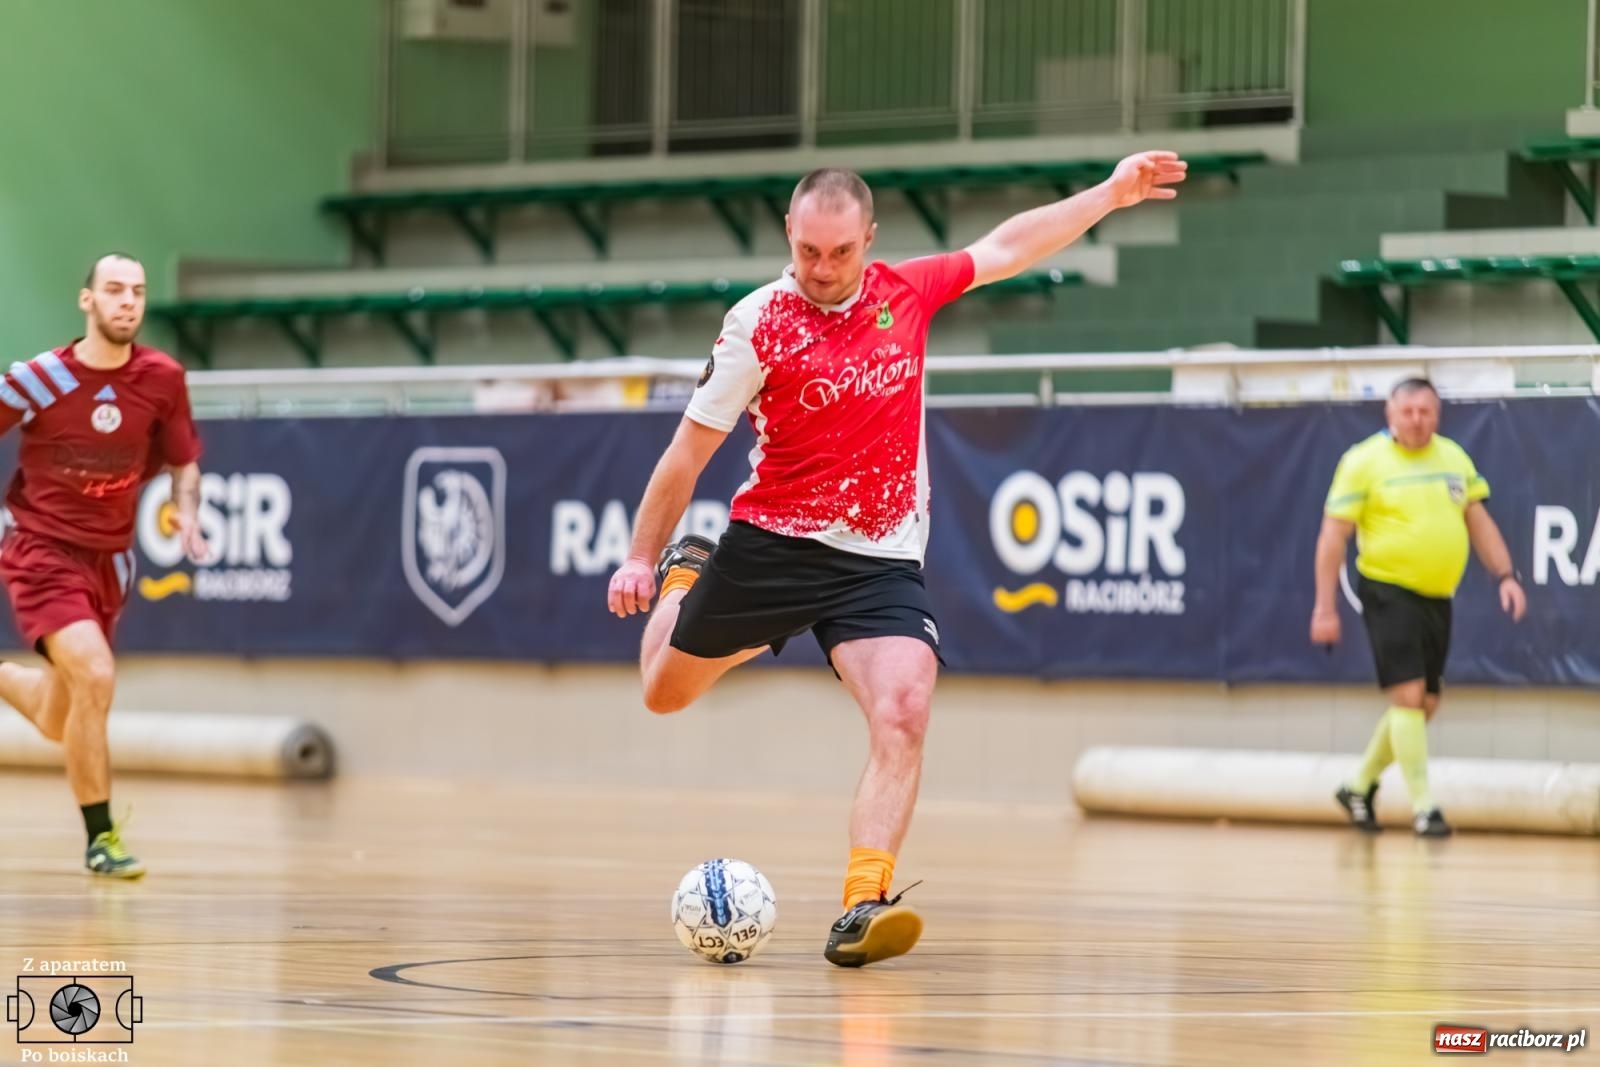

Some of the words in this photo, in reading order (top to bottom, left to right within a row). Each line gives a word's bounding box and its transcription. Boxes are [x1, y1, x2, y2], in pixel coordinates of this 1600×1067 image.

[799, 351, 919, 411] Wiktoria
[989, 470, 1186, 575] OSiR
[1065, 571, 1185, 615] RACIBÓRZ
[699, 935, 725, 948] ECT
[732, 924, 757, 943] SEL
